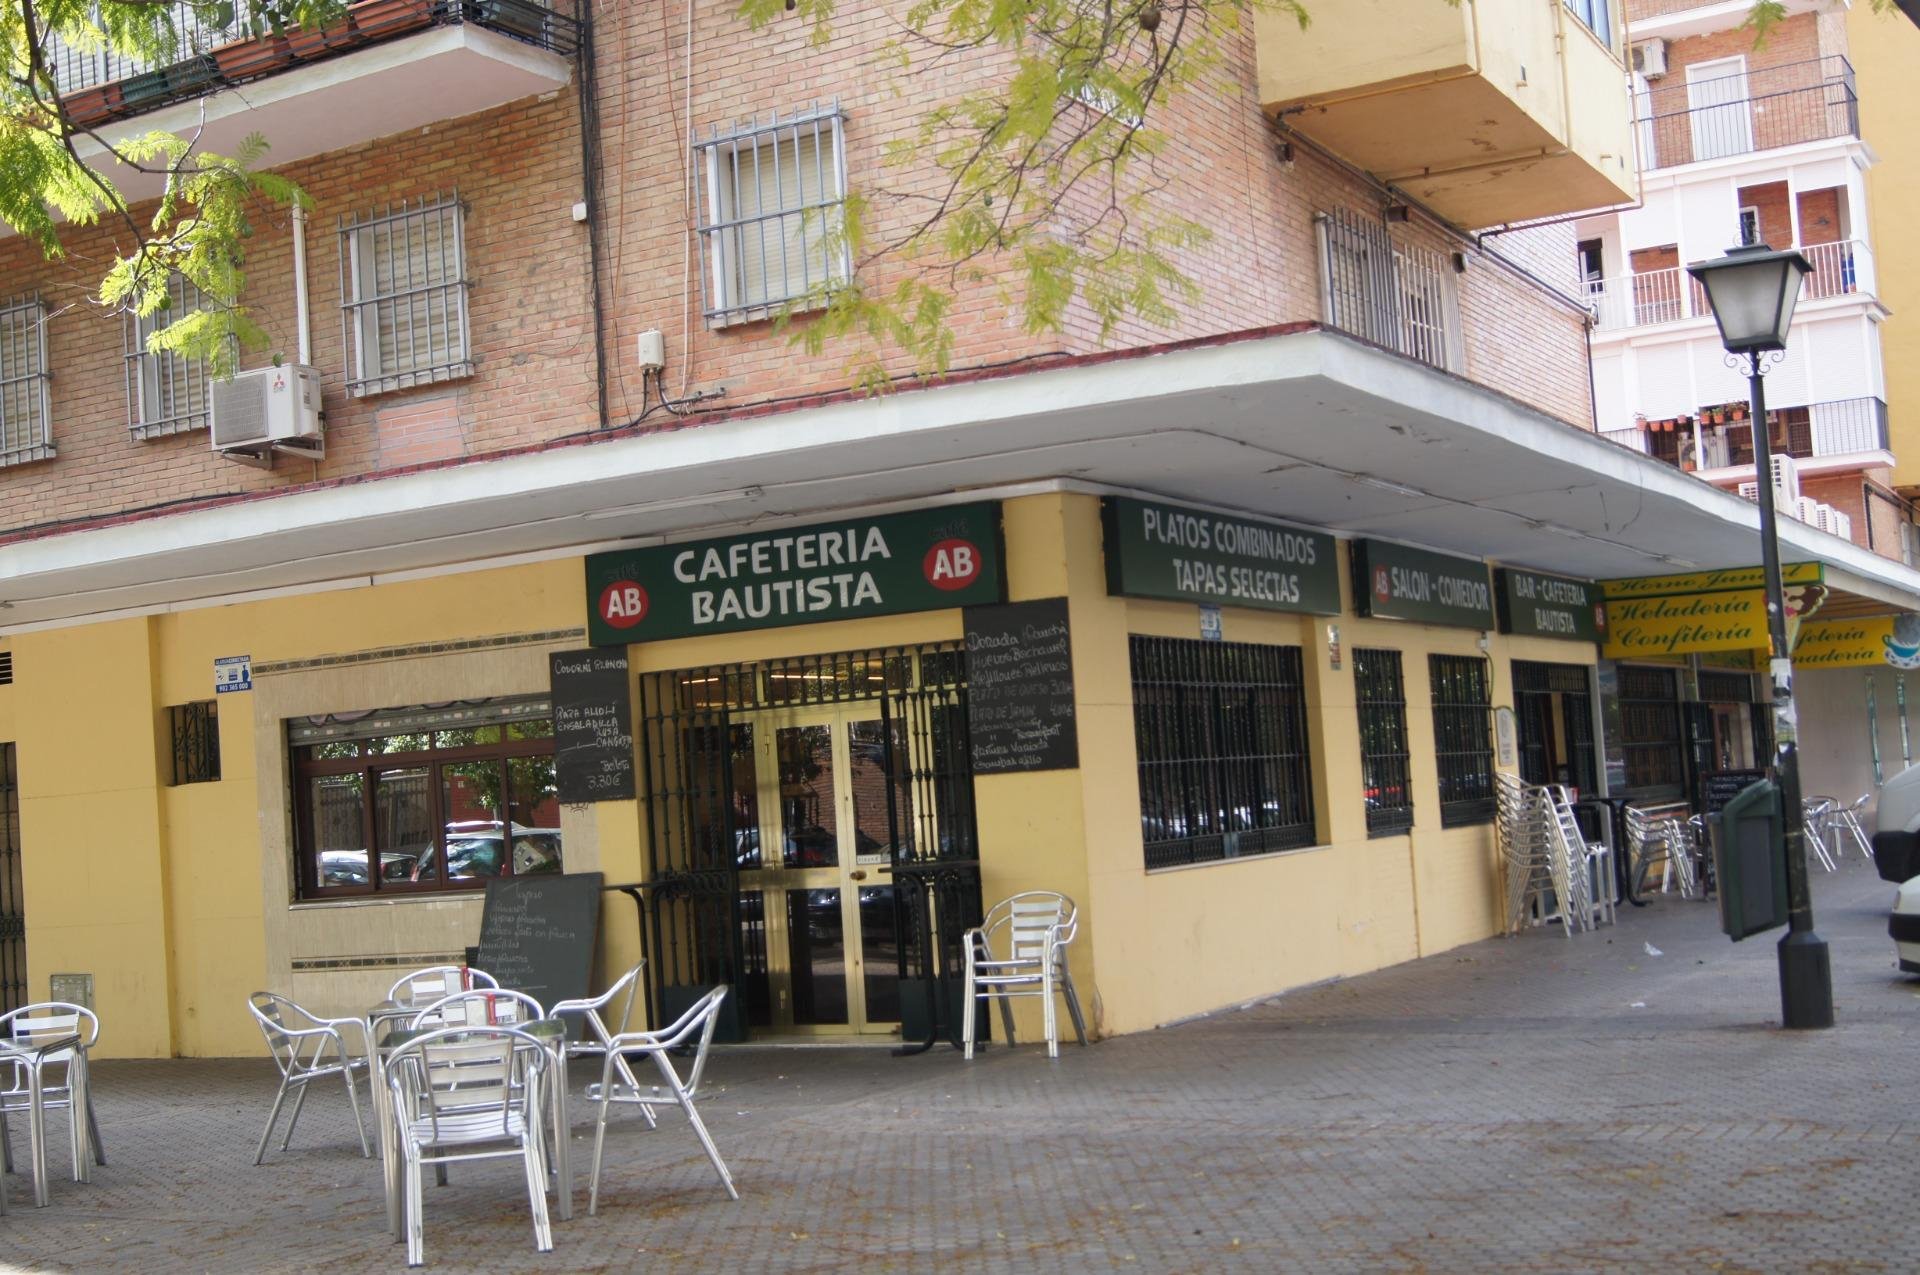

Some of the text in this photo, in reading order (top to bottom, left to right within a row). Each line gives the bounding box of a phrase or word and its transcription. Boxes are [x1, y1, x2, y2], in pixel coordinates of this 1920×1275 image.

[1143, 508, 1316, 565] PLATOS COMBINADOS
[674, 526, 892, 583] CAFETERIA
[933, 546, 974, 580] AB
[1173, 558, 1301, 603] TAPAS SELECTAS
[1376, 570, 1389, 594] AB
[1391, 566, 1431, 602] SALON
[1438, 575, 1489, 610] COMEDOR
[1515, 574, 1536, 599] BAR
[1542, 579, 1588, 607] CAFETERIA
[1611, 577, 1697, 593] Horno
[607, 588, 641, 618] AB
[692, 571, 883, 624] BAUTISTA
[1611, 596, 1751, 621] Heladería
[1535, 608, 1576, 633] BAUTISTA
[1616, 622, 1752, 652] Confitería
[1797, 626, 1866, 649] fetería
